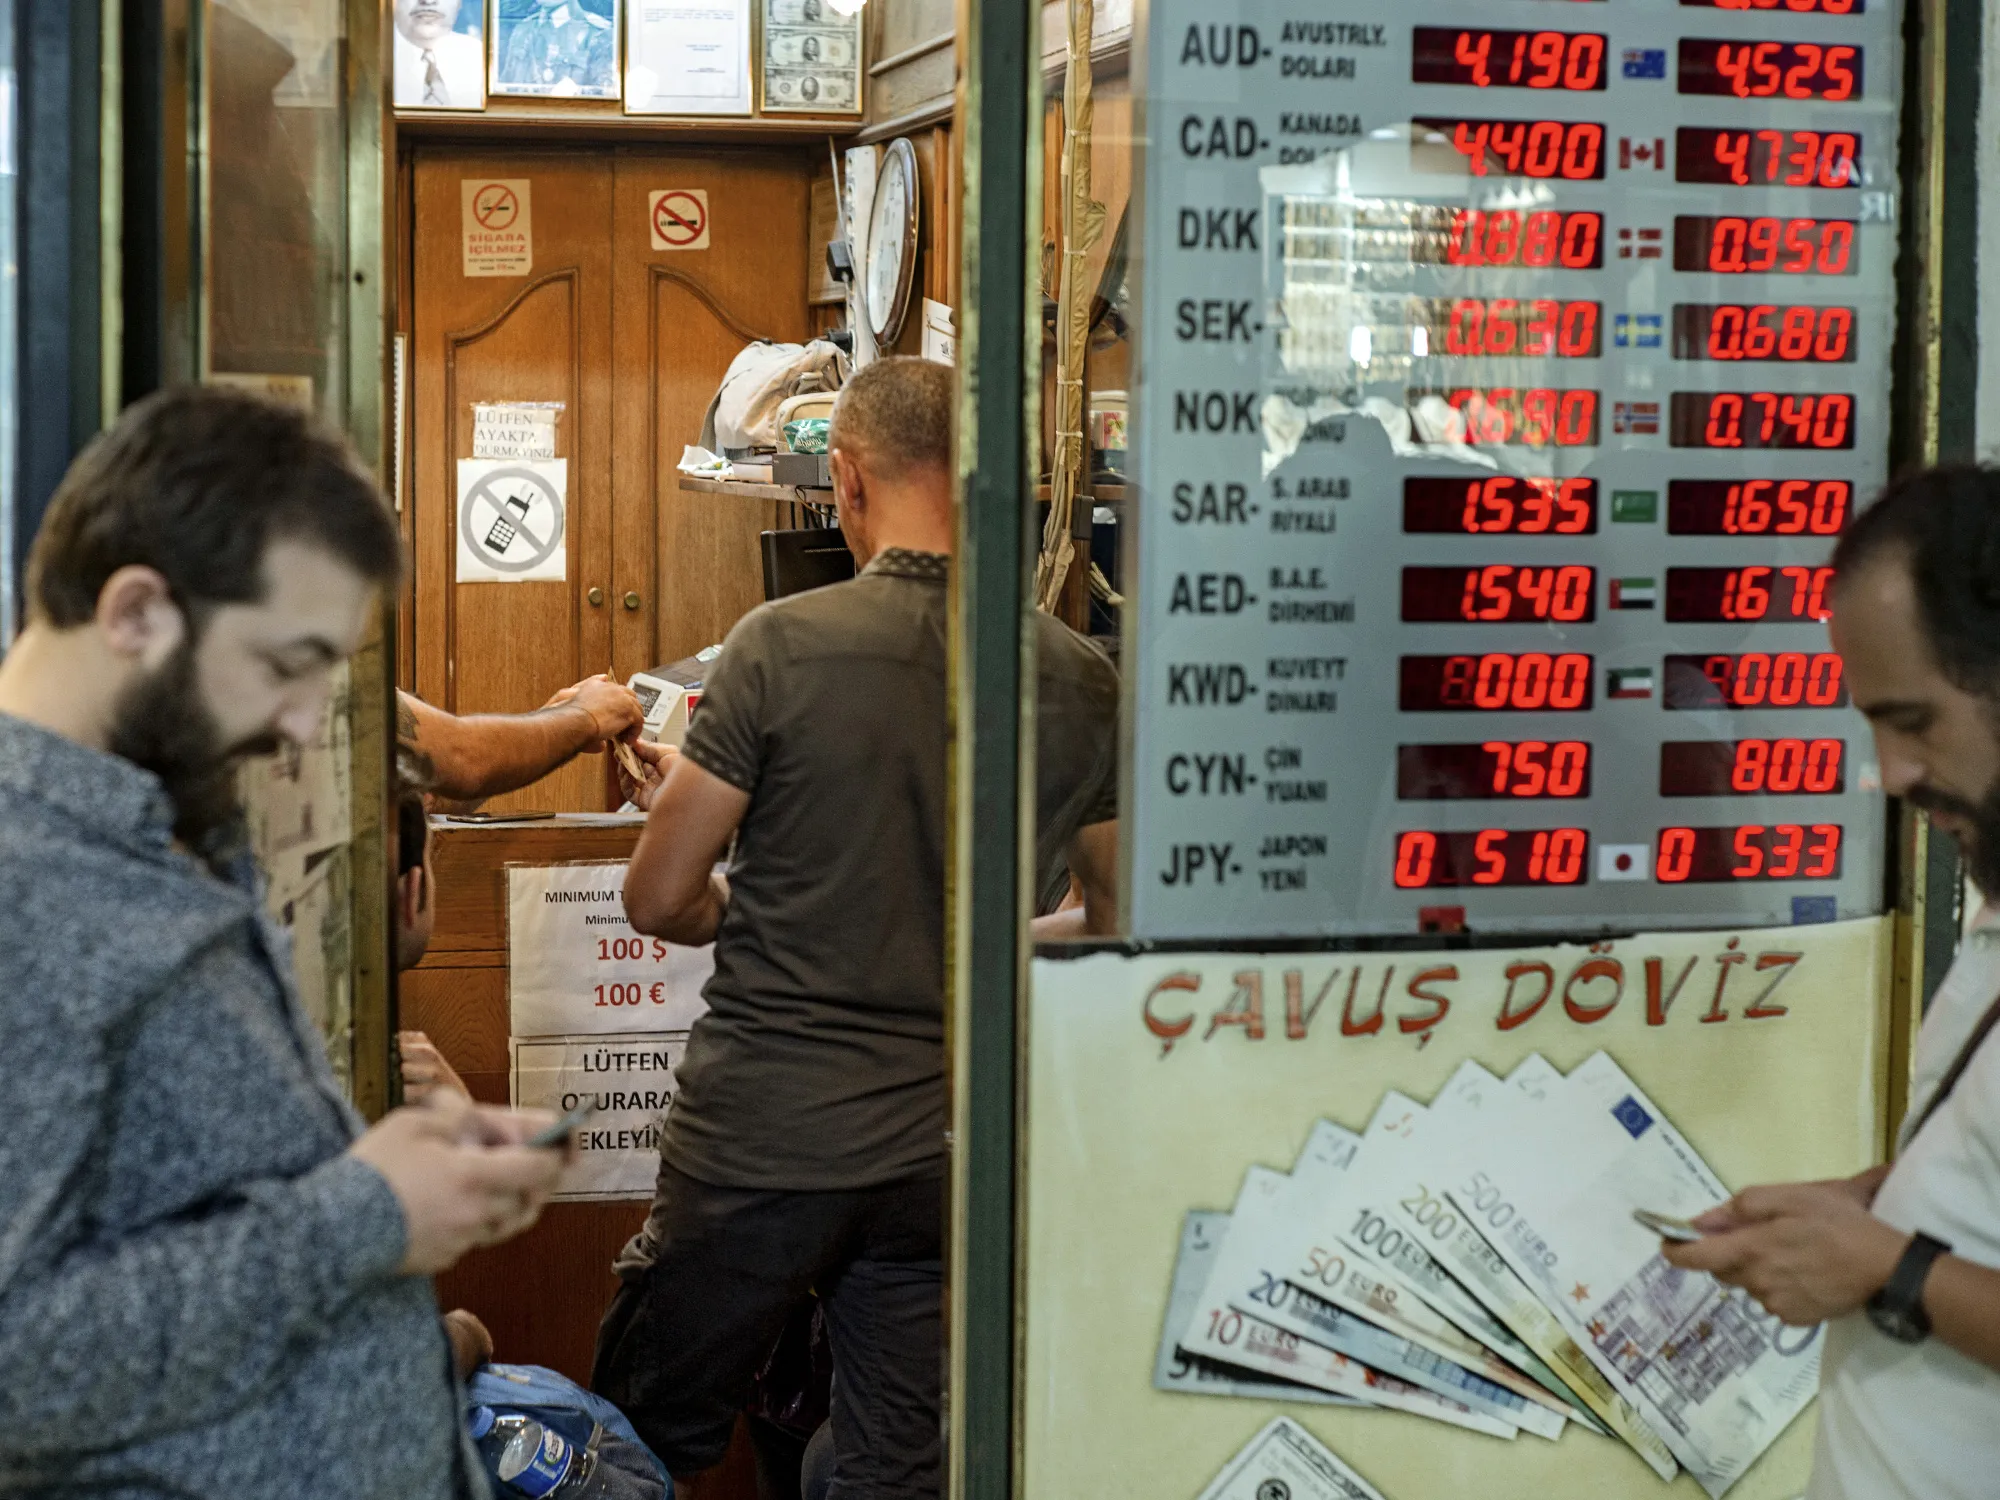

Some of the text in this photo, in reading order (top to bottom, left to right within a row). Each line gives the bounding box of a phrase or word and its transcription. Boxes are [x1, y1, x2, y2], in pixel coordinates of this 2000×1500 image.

[1280, 55, 1355, 79] DOLARI
[1279, 112, 1363, 137] KANADA
[477, 411, 534, 426] LÜTFEN
[1483, 741, 1587, 796] 750
[1732, 738, 1841, 792] 800
[1258, 835, 1328, 859] JAPON
[545, 890, 615, 904] MINIMUM
[585, 914, 630, 926] Minimu
[597, 938, 667, 963] 100 $
[594, 982, 666, 1007] 100 €
[1142, 936, 1804, 1058] ÇAVUŞ DÖVİZ
[583, 1049, 669, 1073] LÜTFEN
[561, 1091, 672, 1113] OTURARA
[1400, 1183, 1506, 1275] 200 EURO
[1460, 1171, 1560, 1269] 500 EURO
[1350, 1207, 1404, 1259] 100
[1300, 1246, 1346, 1288] 50
[1248, 1268, 1290, 1308] 20
[1207, 1308, 1243, 1345] 10
